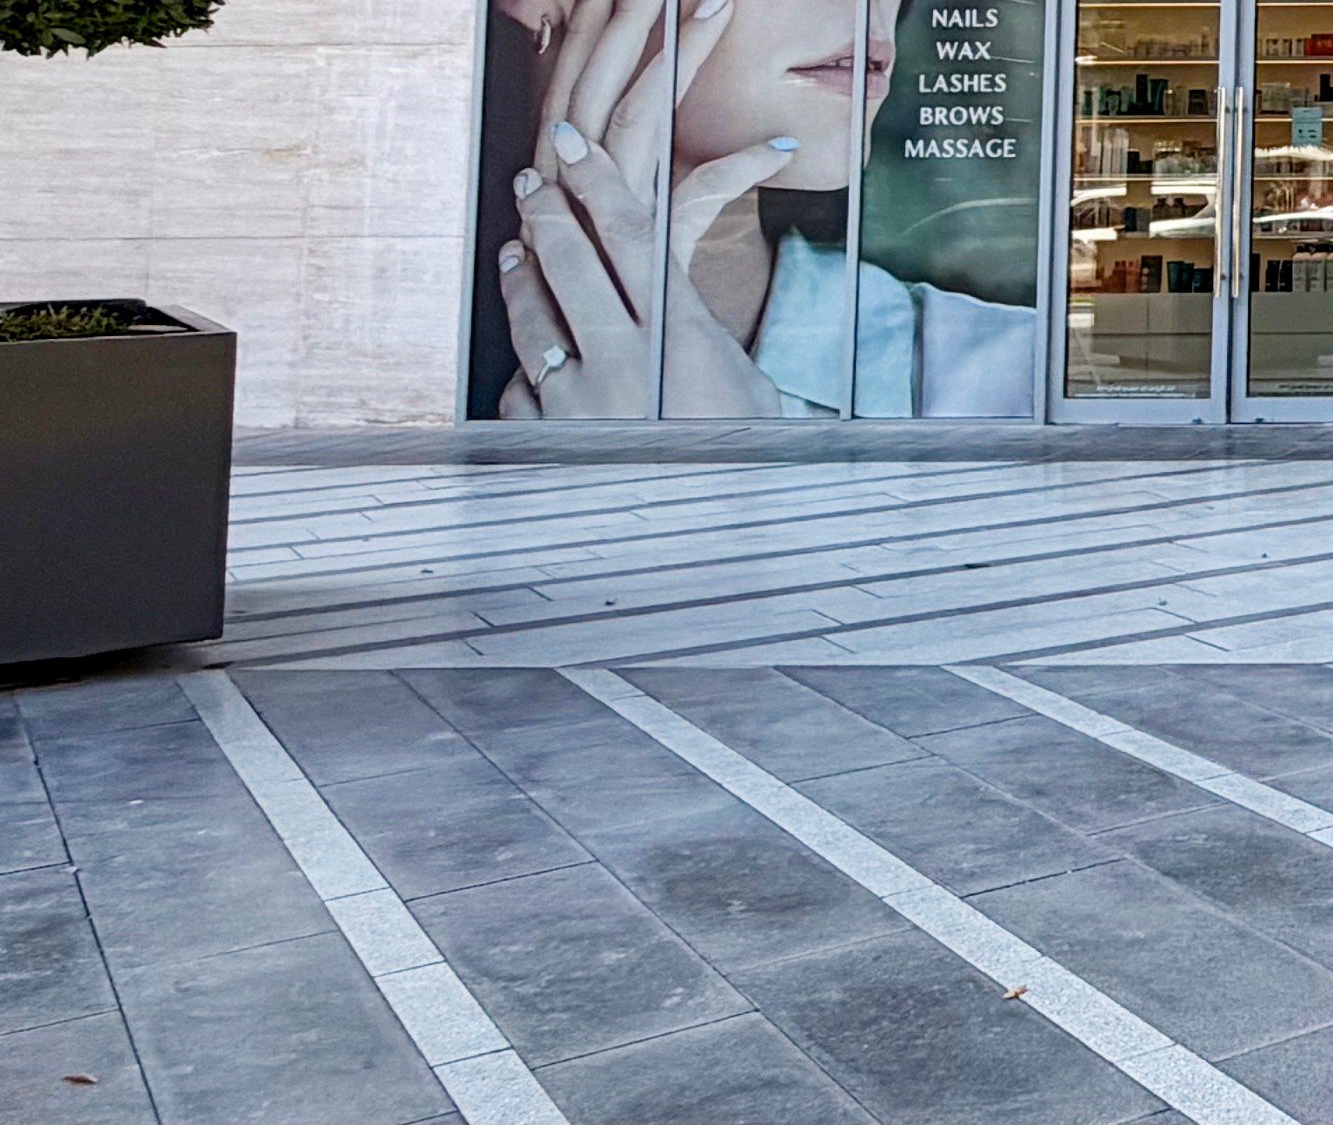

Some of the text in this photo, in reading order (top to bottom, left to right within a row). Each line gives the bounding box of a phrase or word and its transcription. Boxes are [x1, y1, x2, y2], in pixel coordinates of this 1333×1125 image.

[931, 8, 999, 28] NAILS
[936, 41, 992, 60] WAX
[918, 74, 1007, 93] LASHES
[919, 106, 1004, 125] BROWS
[904, 139, 1017, 158] MASSAGE
